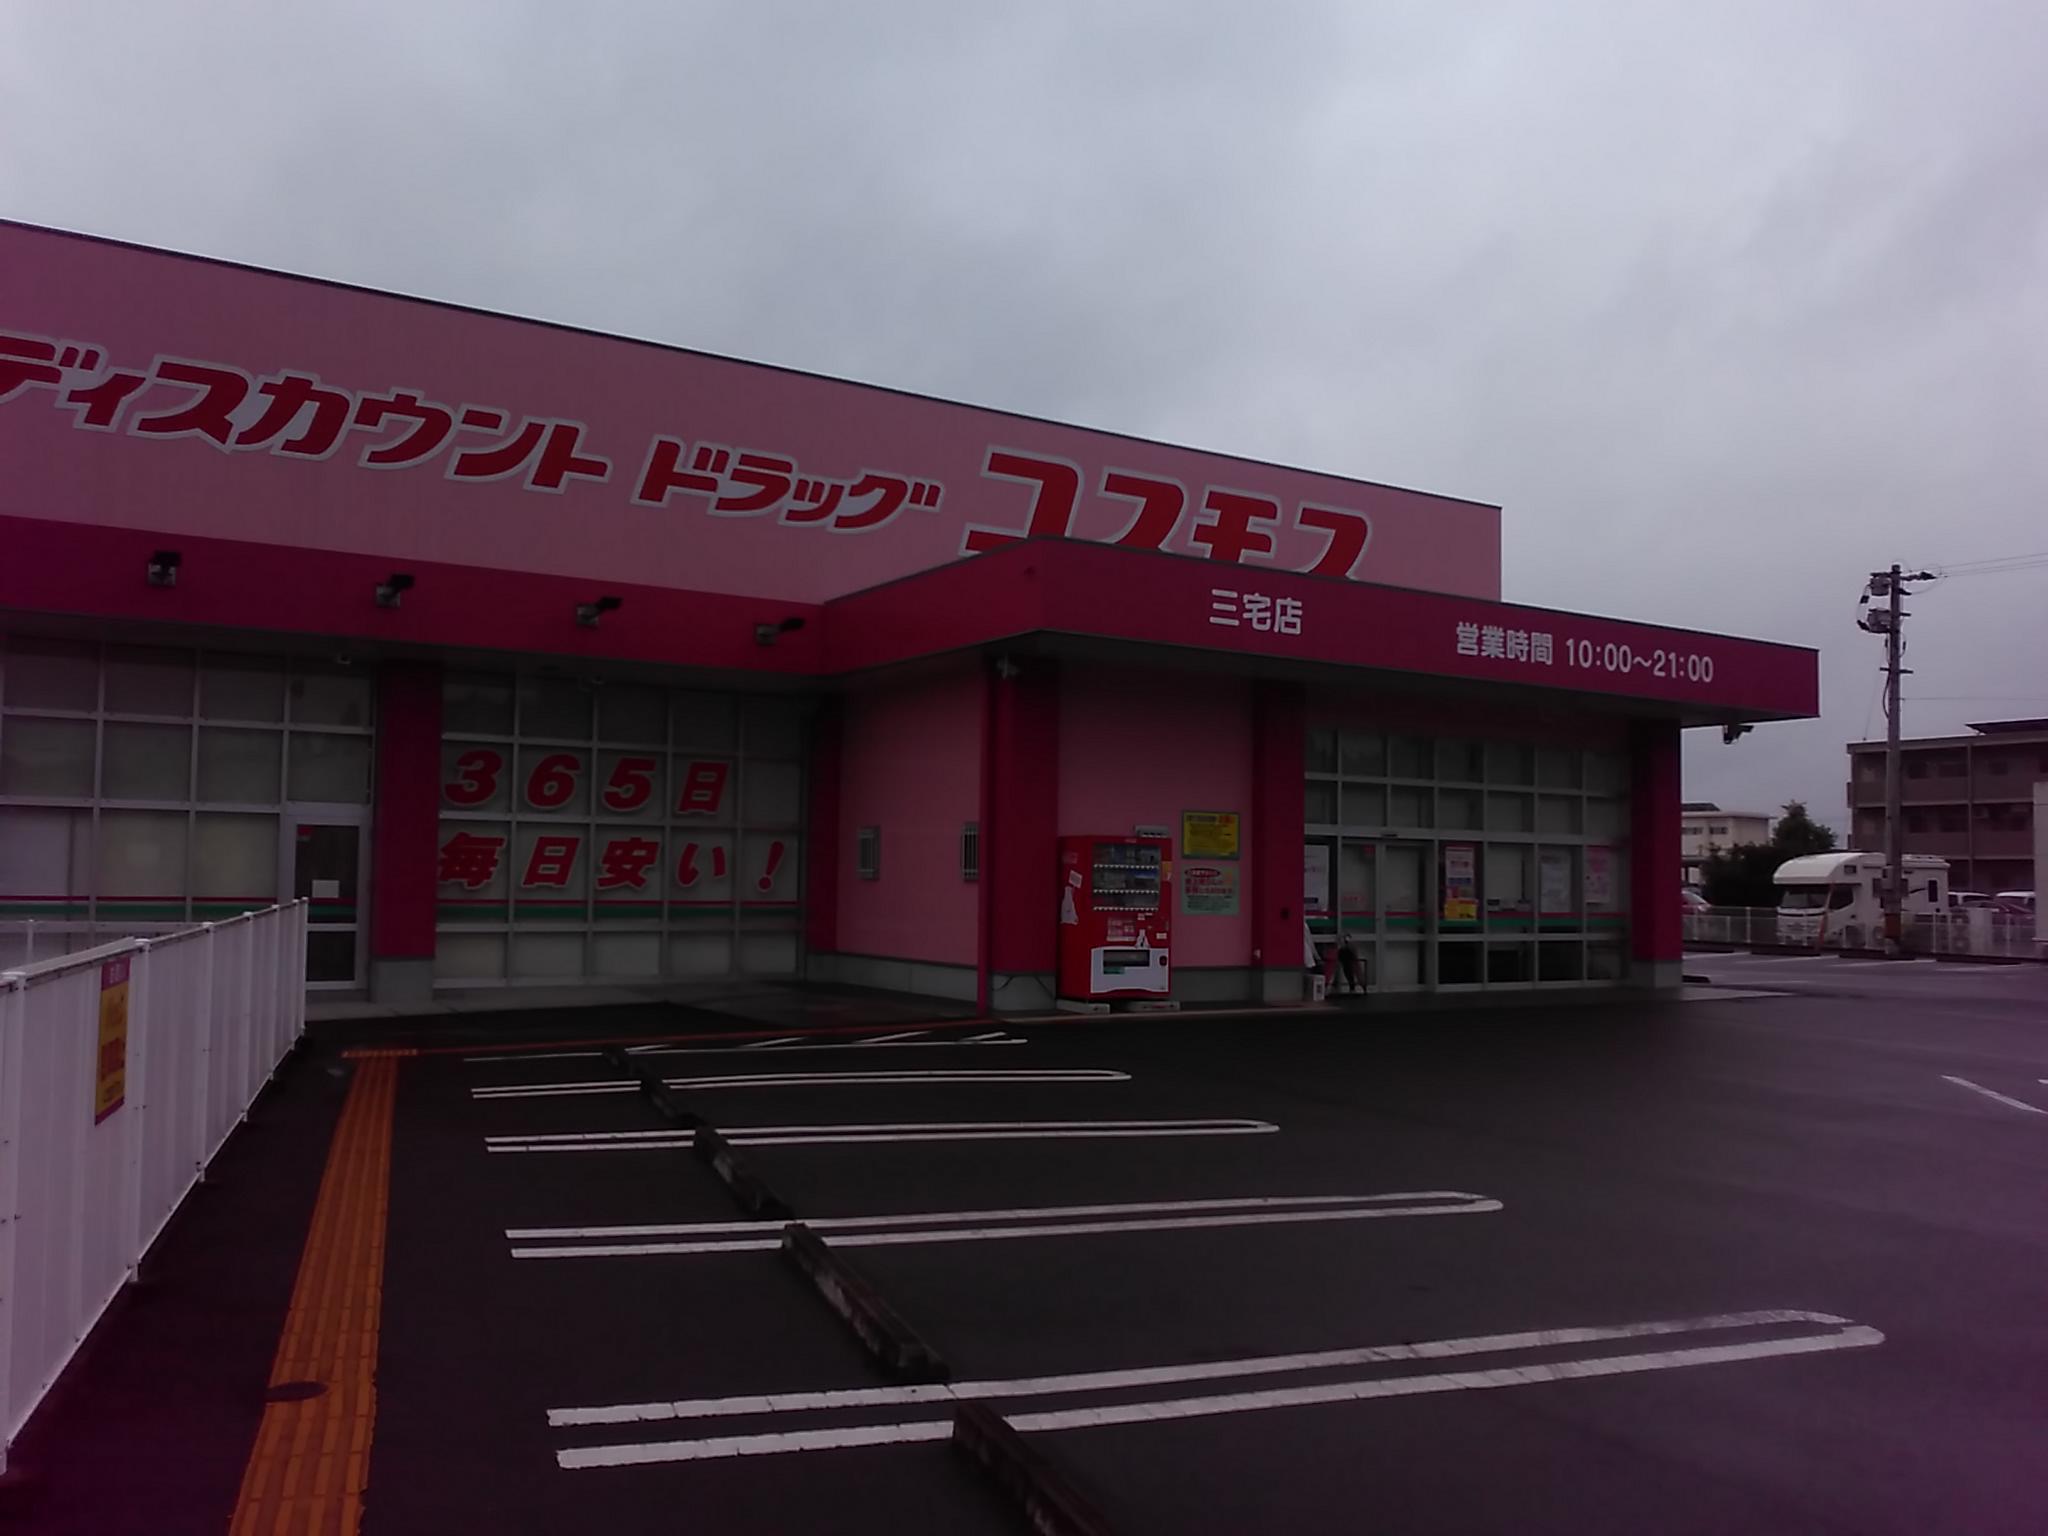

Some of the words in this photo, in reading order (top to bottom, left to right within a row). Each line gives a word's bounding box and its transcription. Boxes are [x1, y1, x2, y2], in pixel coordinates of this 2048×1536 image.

[0, 332, 608, 490] ディスカウント
[635, 437, 942, 530] ドラッグ
[1209, 588, 1303, 636] 三宅店
[1456, 621, 1553, 666] 営業時間
